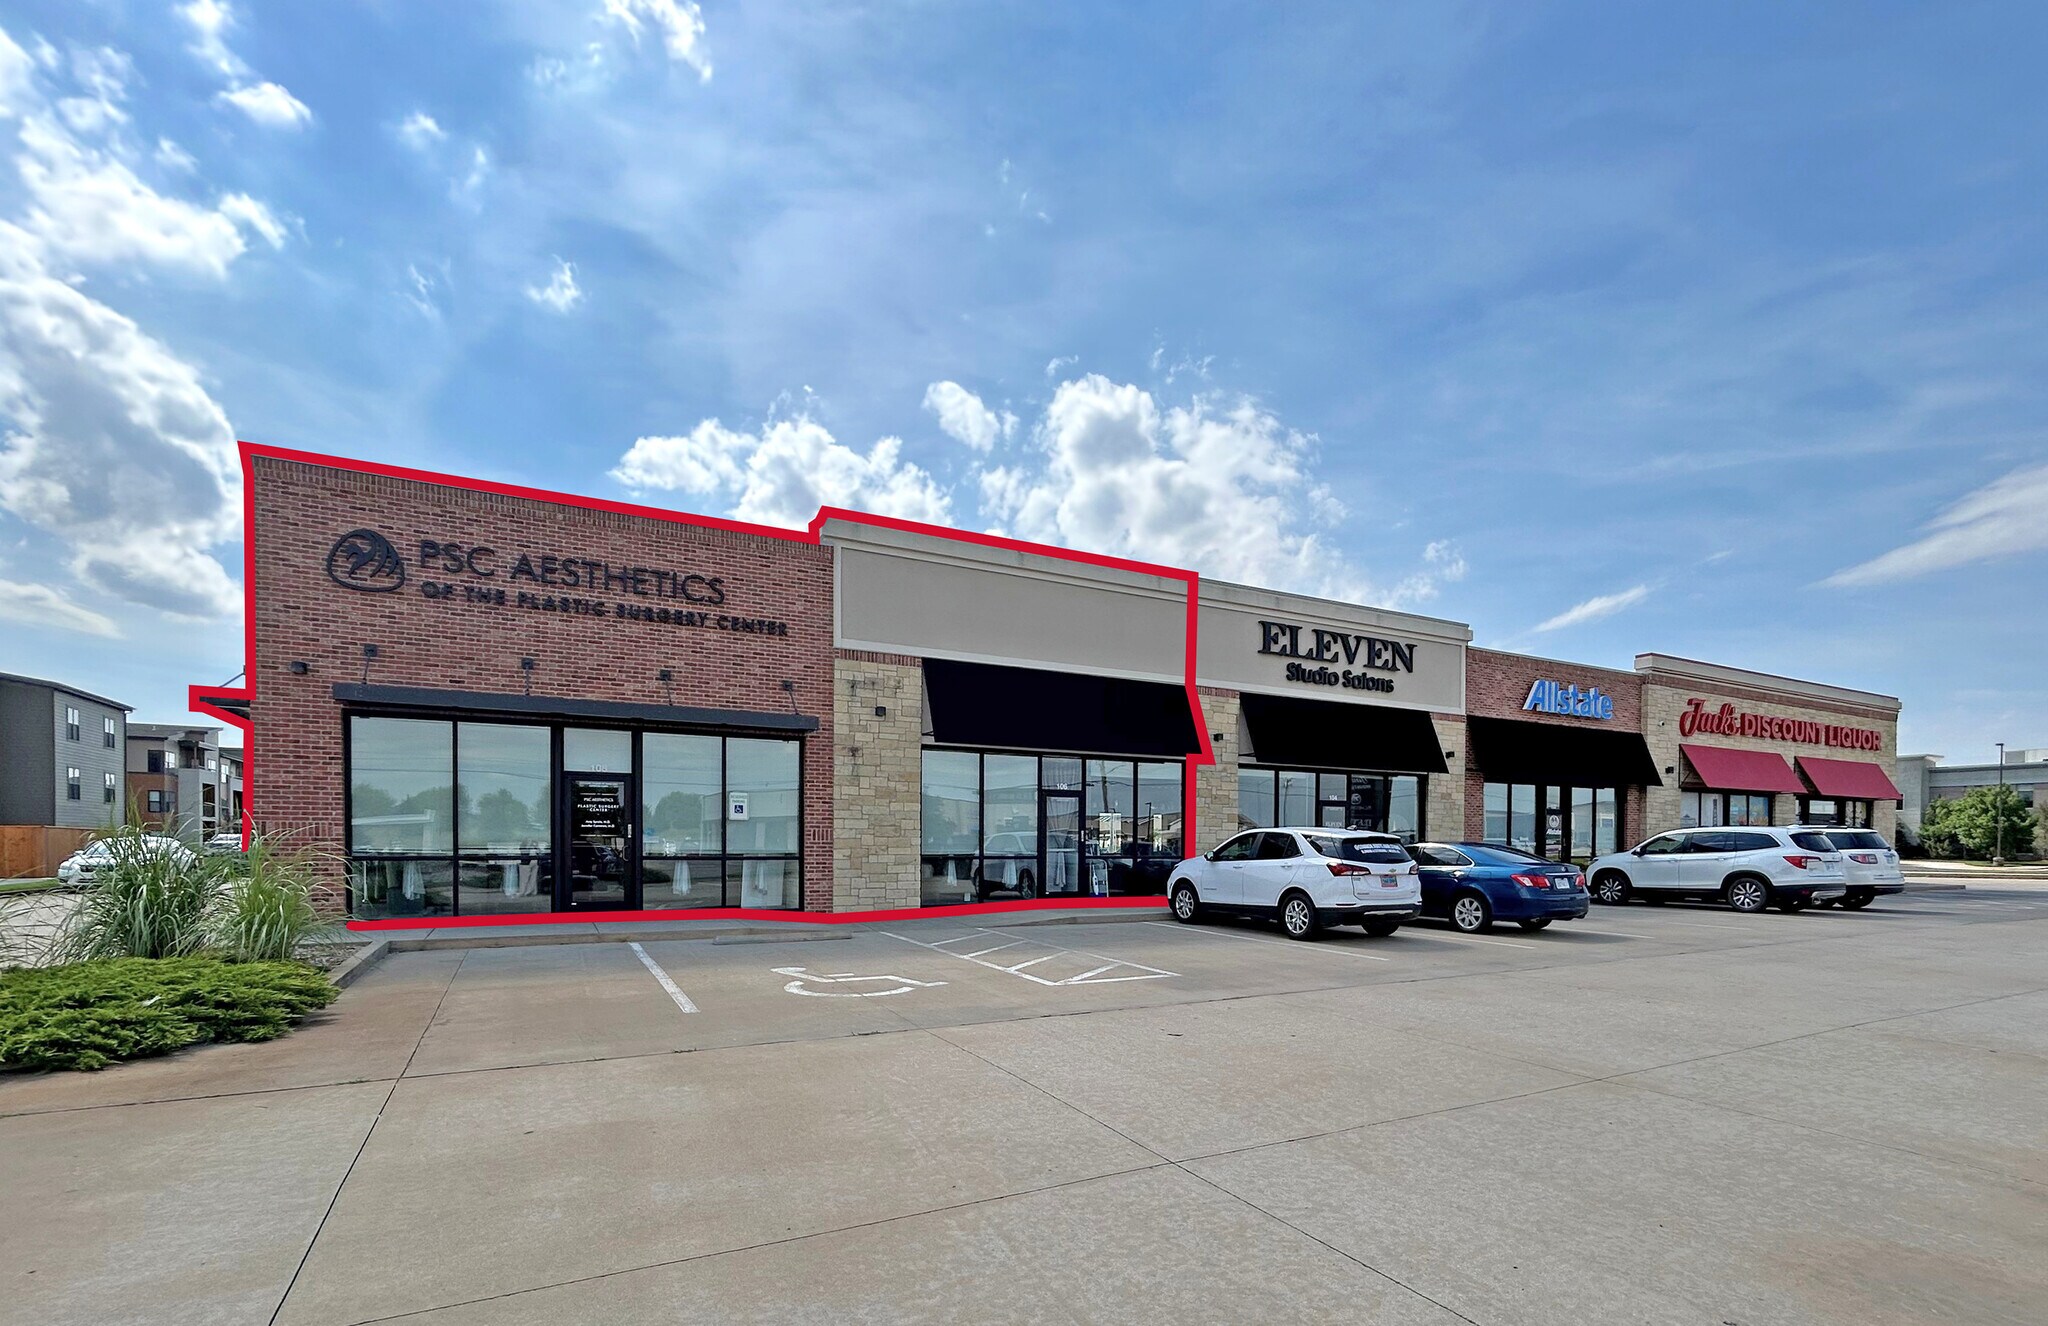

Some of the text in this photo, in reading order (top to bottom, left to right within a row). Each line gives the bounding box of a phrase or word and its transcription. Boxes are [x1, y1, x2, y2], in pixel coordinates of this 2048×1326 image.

[420, 539, 725, 605] PSC AESTHETICS
[420, 581, 788, 637] OF THE PLASTIC SURGERY CENTER
[1257, 620, 1418, 673] ELEVEN
[1286, 662, 1395, 693] Studio Salons
[1522, 679, 1614, 720] Allstate
[1679, 697, 1882, 751] Jack's DISCOUNT LIQUOR
